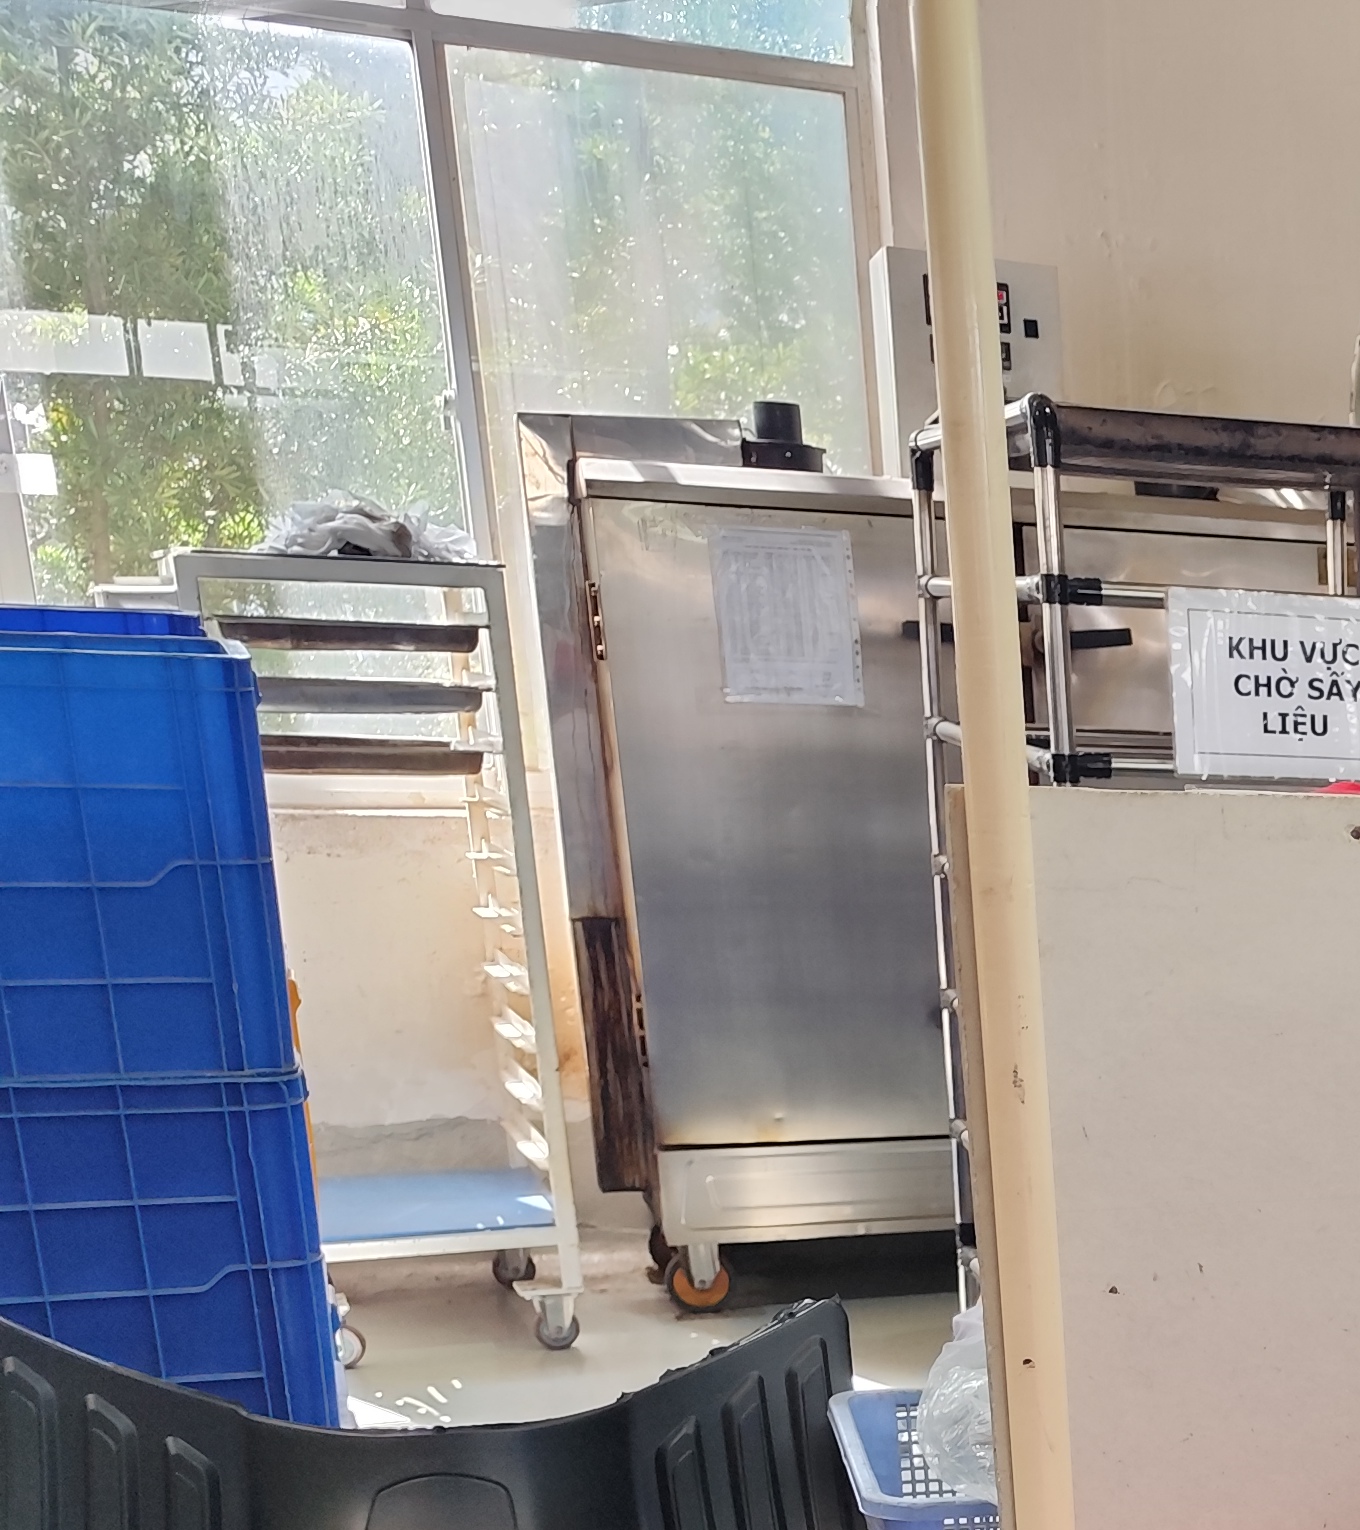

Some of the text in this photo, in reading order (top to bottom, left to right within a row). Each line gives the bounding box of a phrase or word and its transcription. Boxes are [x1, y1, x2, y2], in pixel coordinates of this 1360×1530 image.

[1228, 636, 1360, 670] KHU VỰC
[1233, 668, 1299, 698] CHỜ
[1262, 705, 1329, 741] LIỆU
